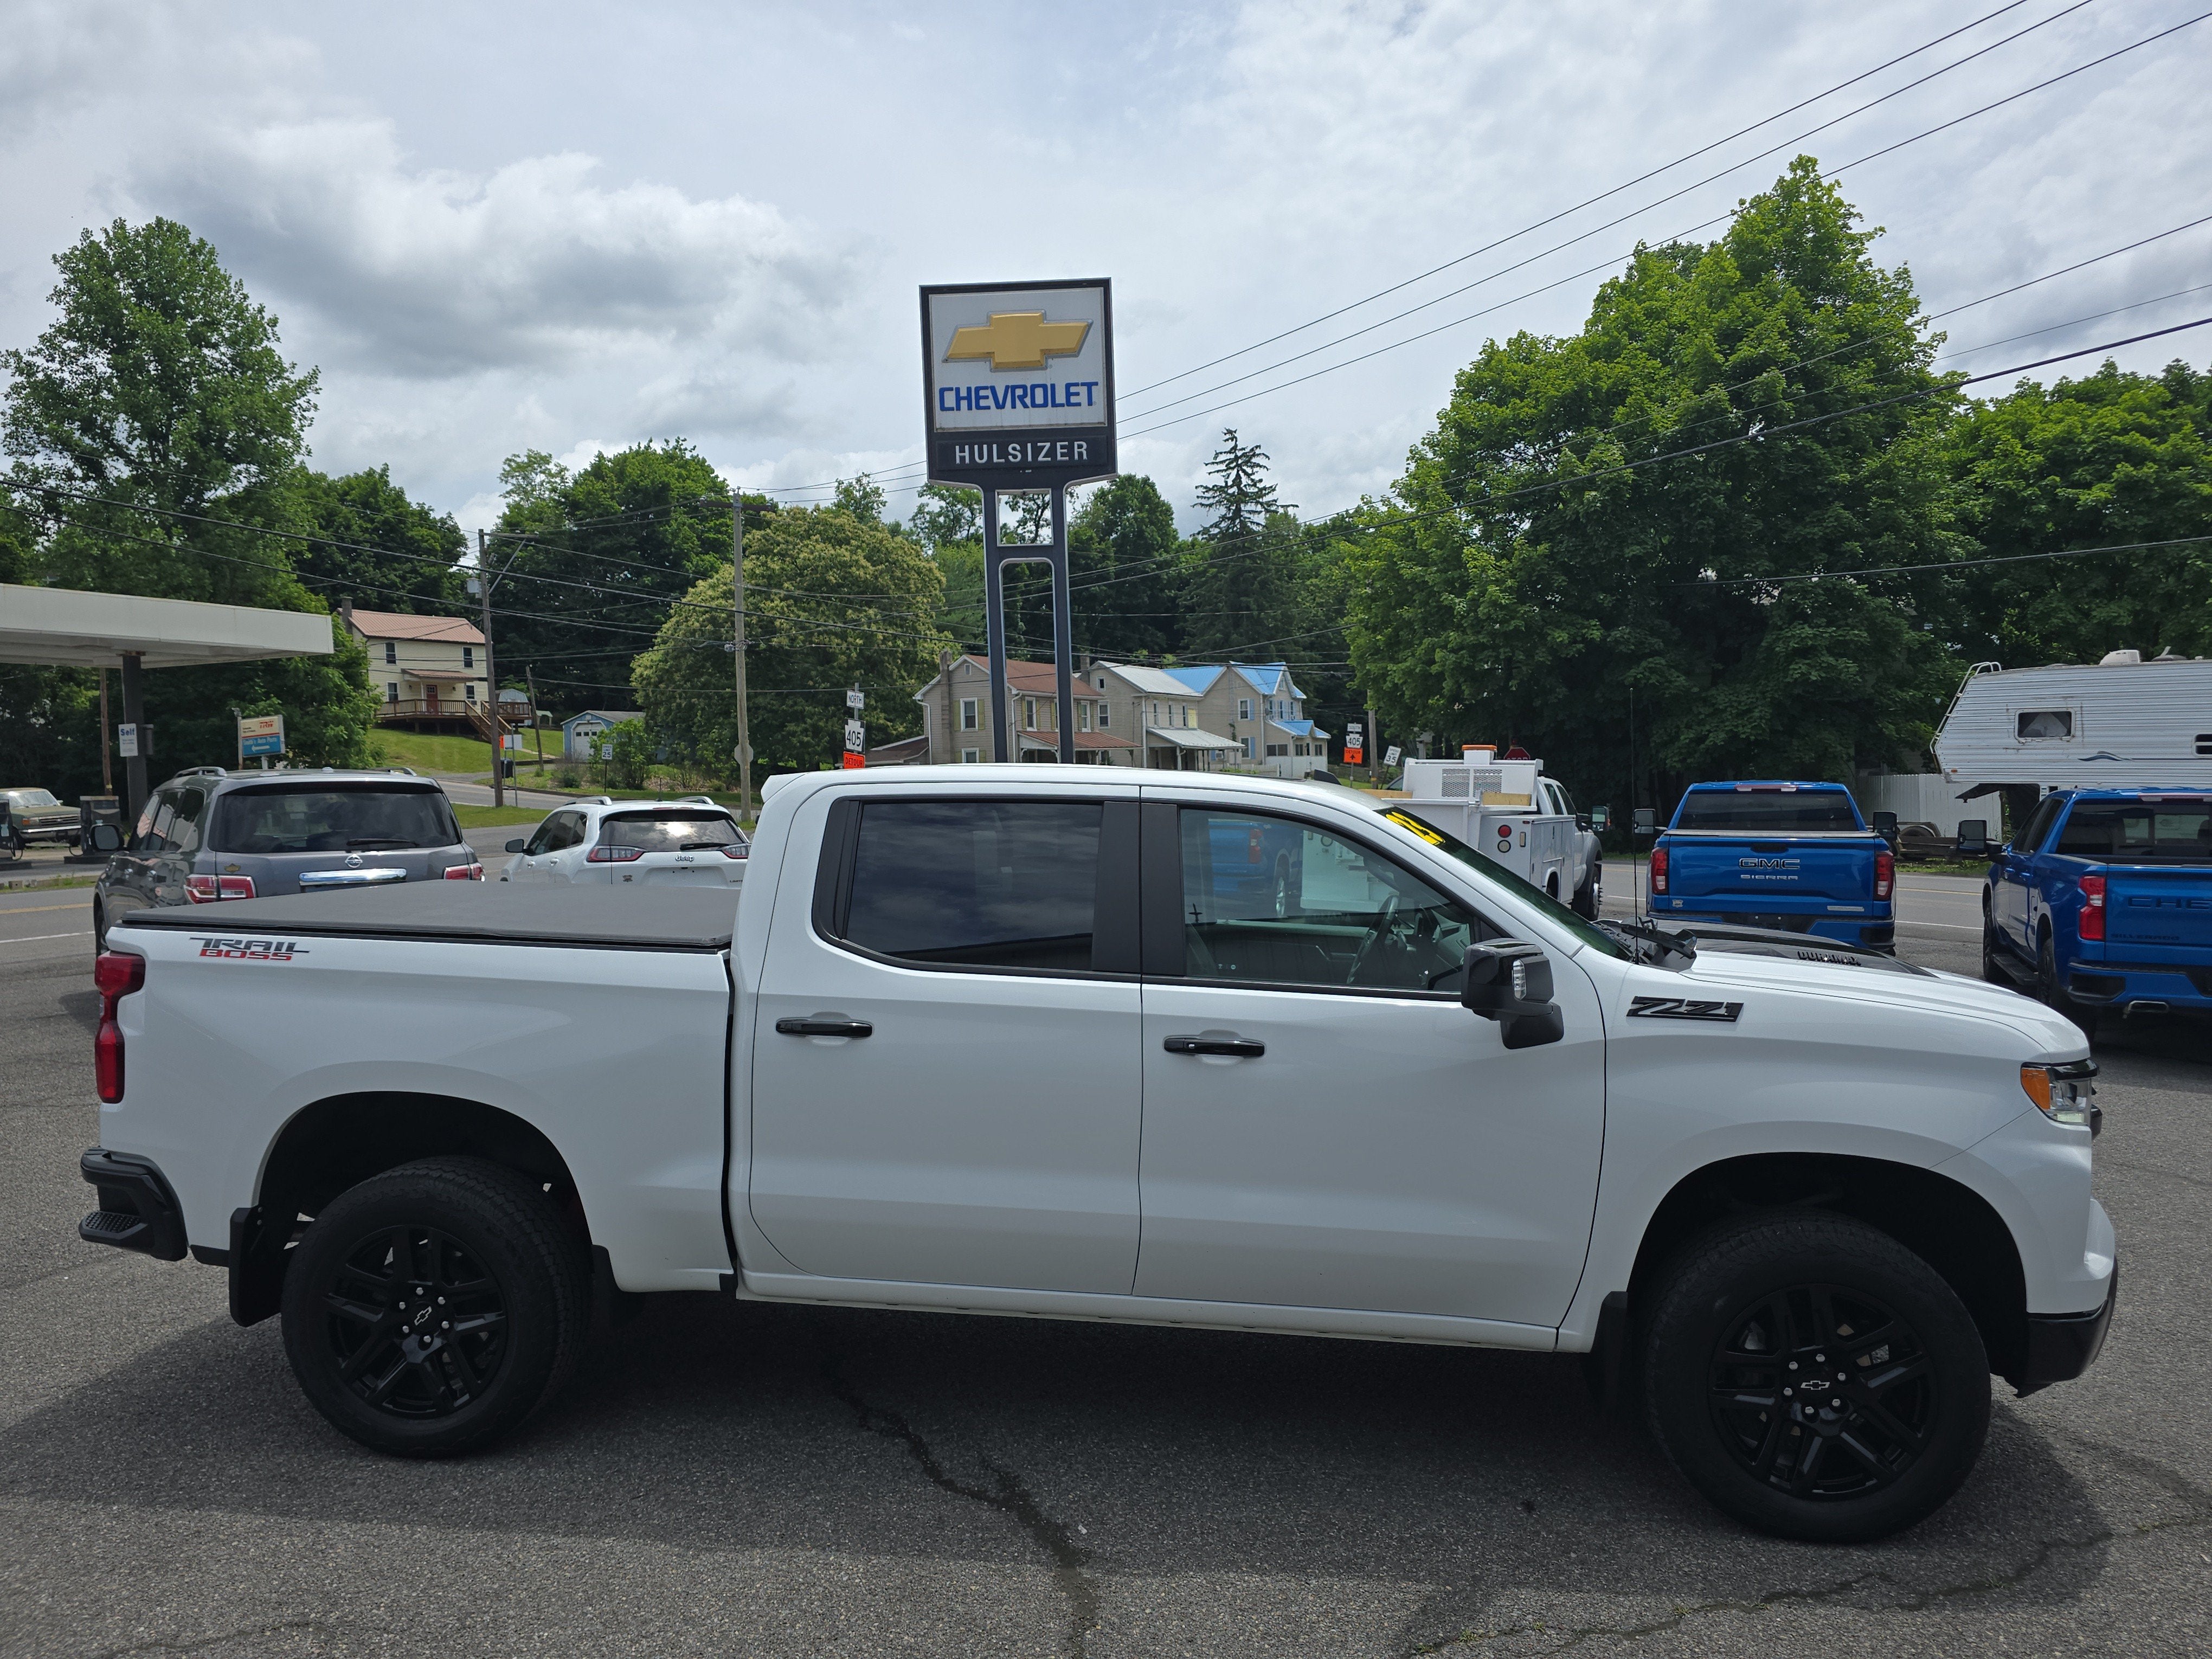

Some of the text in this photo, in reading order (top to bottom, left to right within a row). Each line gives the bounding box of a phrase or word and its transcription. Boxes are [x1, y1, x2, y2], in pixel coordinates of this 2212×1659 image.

[939, 381, 1098, 411] CHEVROLET
[955, 441, 1088, 464] HULSIZER
[848, 695, 862, 704] NORTH
[120, 728, 135, 736] Self
[846, 730, 861, 747] 405
[1348, 737, 1360, 745] 405
[845, 757, 863, 767] DETOUR
[1739, 858, 1800, 869] GMC
[190, 937, 310, 953] TRAIL
[200, 948, 293, 960] BOSS
[1797, 950, 1862, 966] DURAMAX
[1626, 996, 1744, 1022] Z71
